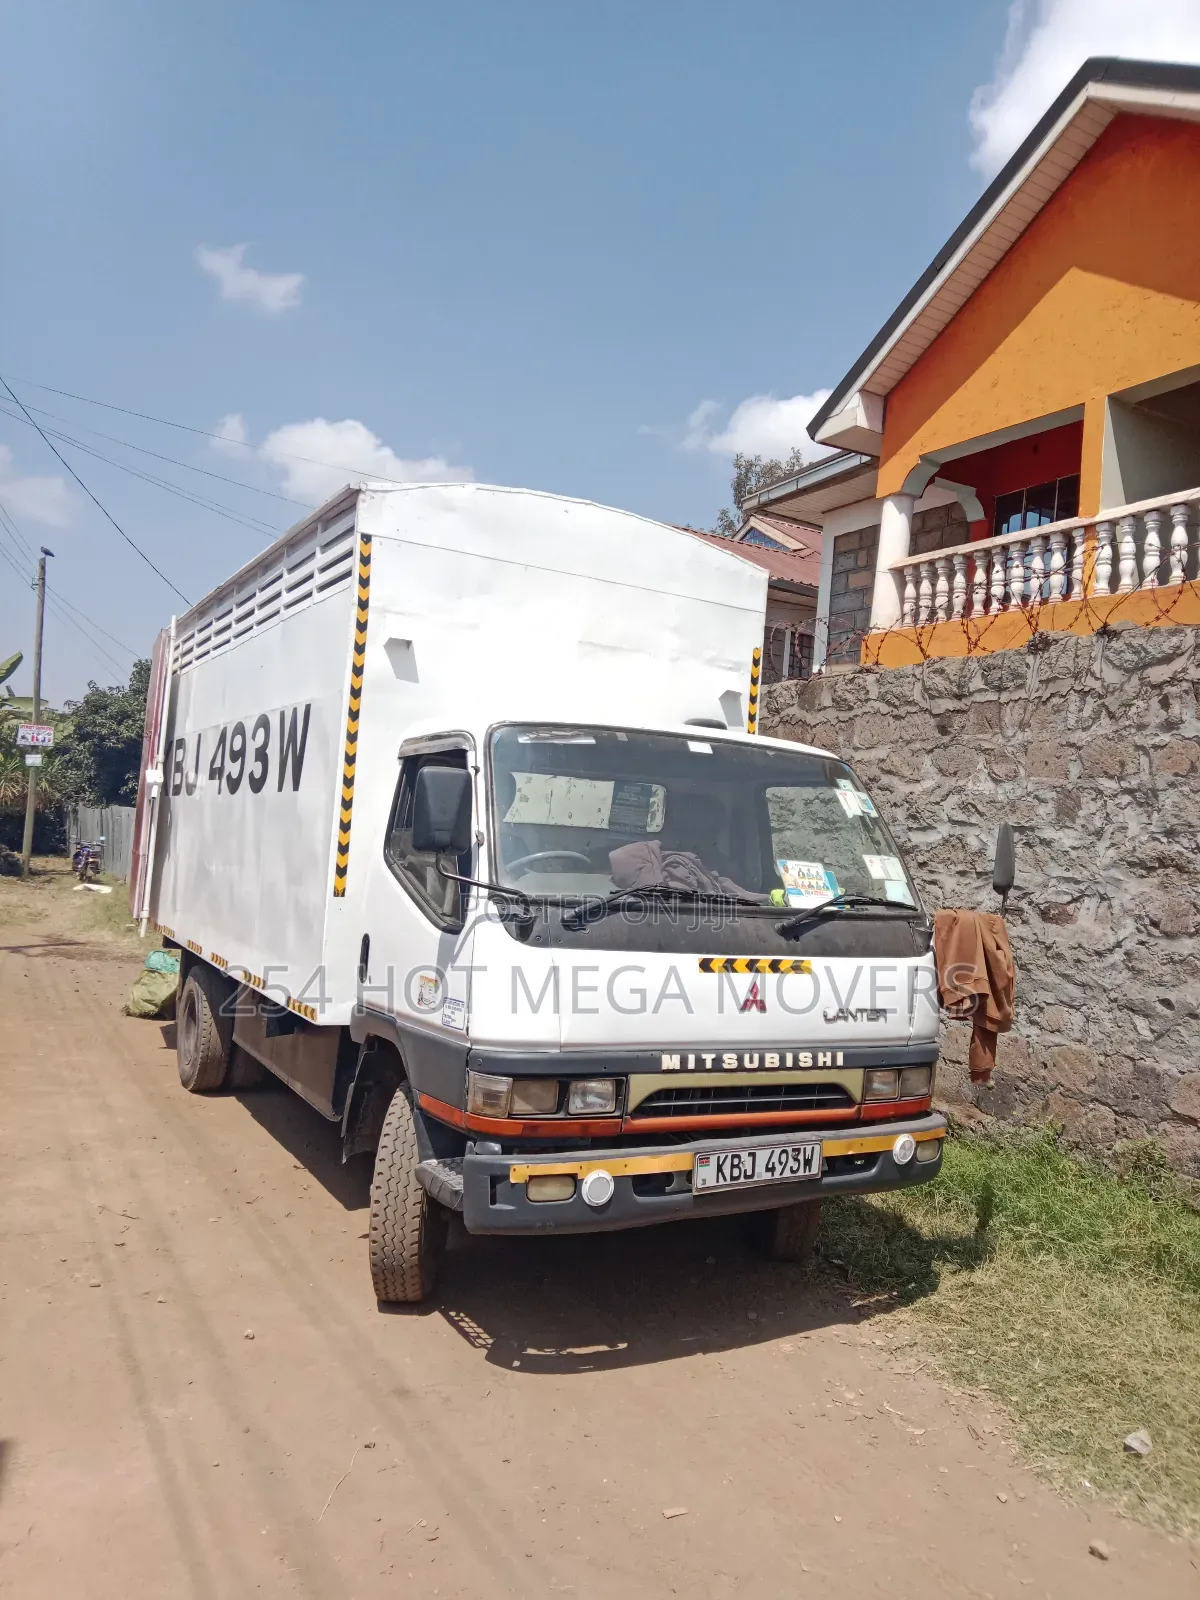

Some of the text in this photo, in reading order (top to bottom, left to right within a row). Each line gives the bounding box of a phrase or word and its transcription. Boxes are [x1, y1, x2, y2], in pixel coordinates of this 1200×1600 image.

[208, 703, 311, 796] 493W
[661, 1051, 844, 1071] MITSUBISHI
[716, 1146, 815, 1184] KBJ 493W
